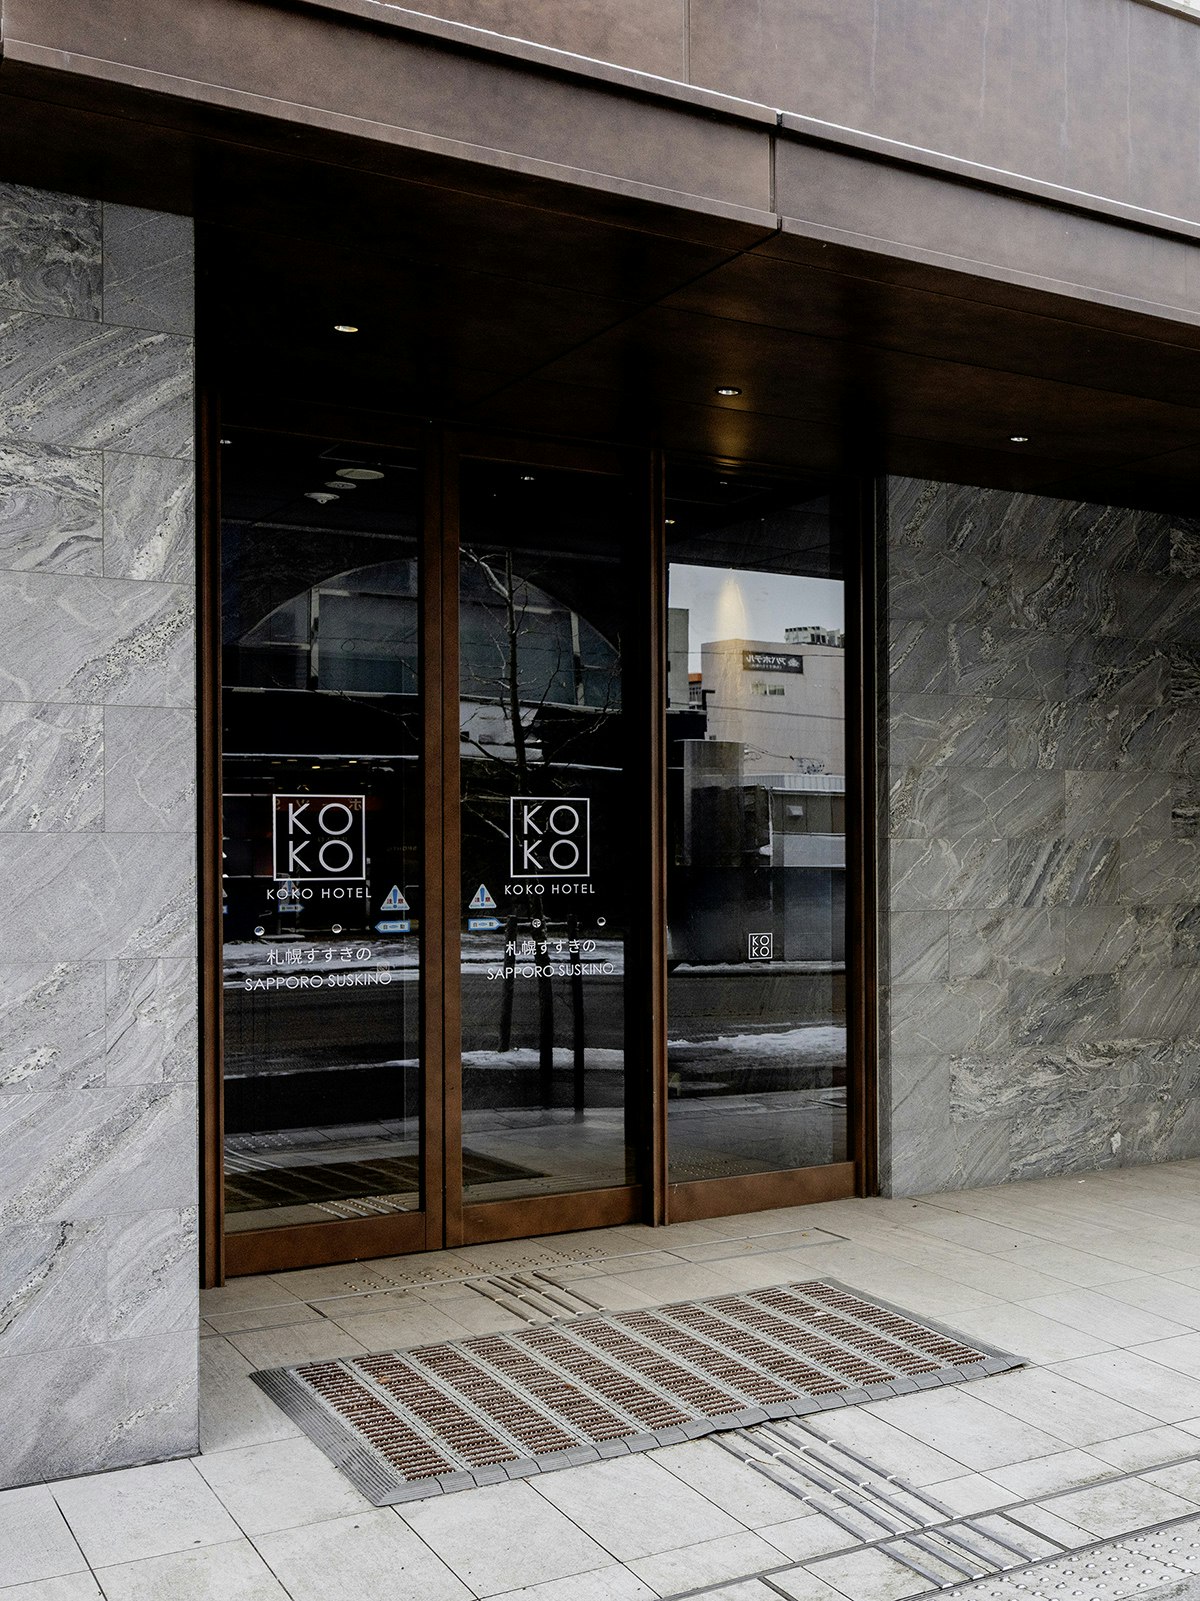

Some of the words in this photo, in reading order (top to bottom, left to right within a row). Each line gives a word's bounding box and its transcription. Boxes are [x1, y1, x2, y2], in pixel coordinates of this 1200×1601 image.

[288, 802, 353, 836] KO
[523, 805, 580, 835] KO
[288, 839, 353, 873] KO
[523, 839, 580, 870] KO
[266, 887, 313, 900] KOKO
[321, 886, 372, 899] HOTEL
[504, 884, 545, 895] KOKO
[551, 883, 596, 895] HOTEL
[505, 939, 596, 956] 札幌すすきの
[752, 935, 770, 946] KO
[266, 947, 372, 966] 札幌すすきの
[752, 946, 770, 957] KO
[486, 965, 555, 980] SAPPORO
[558, 963, 614, 977] SUSKINO
[244, 975, 324, 992] SAPPORO
[327, 972, 392, 988] SUSKINO
